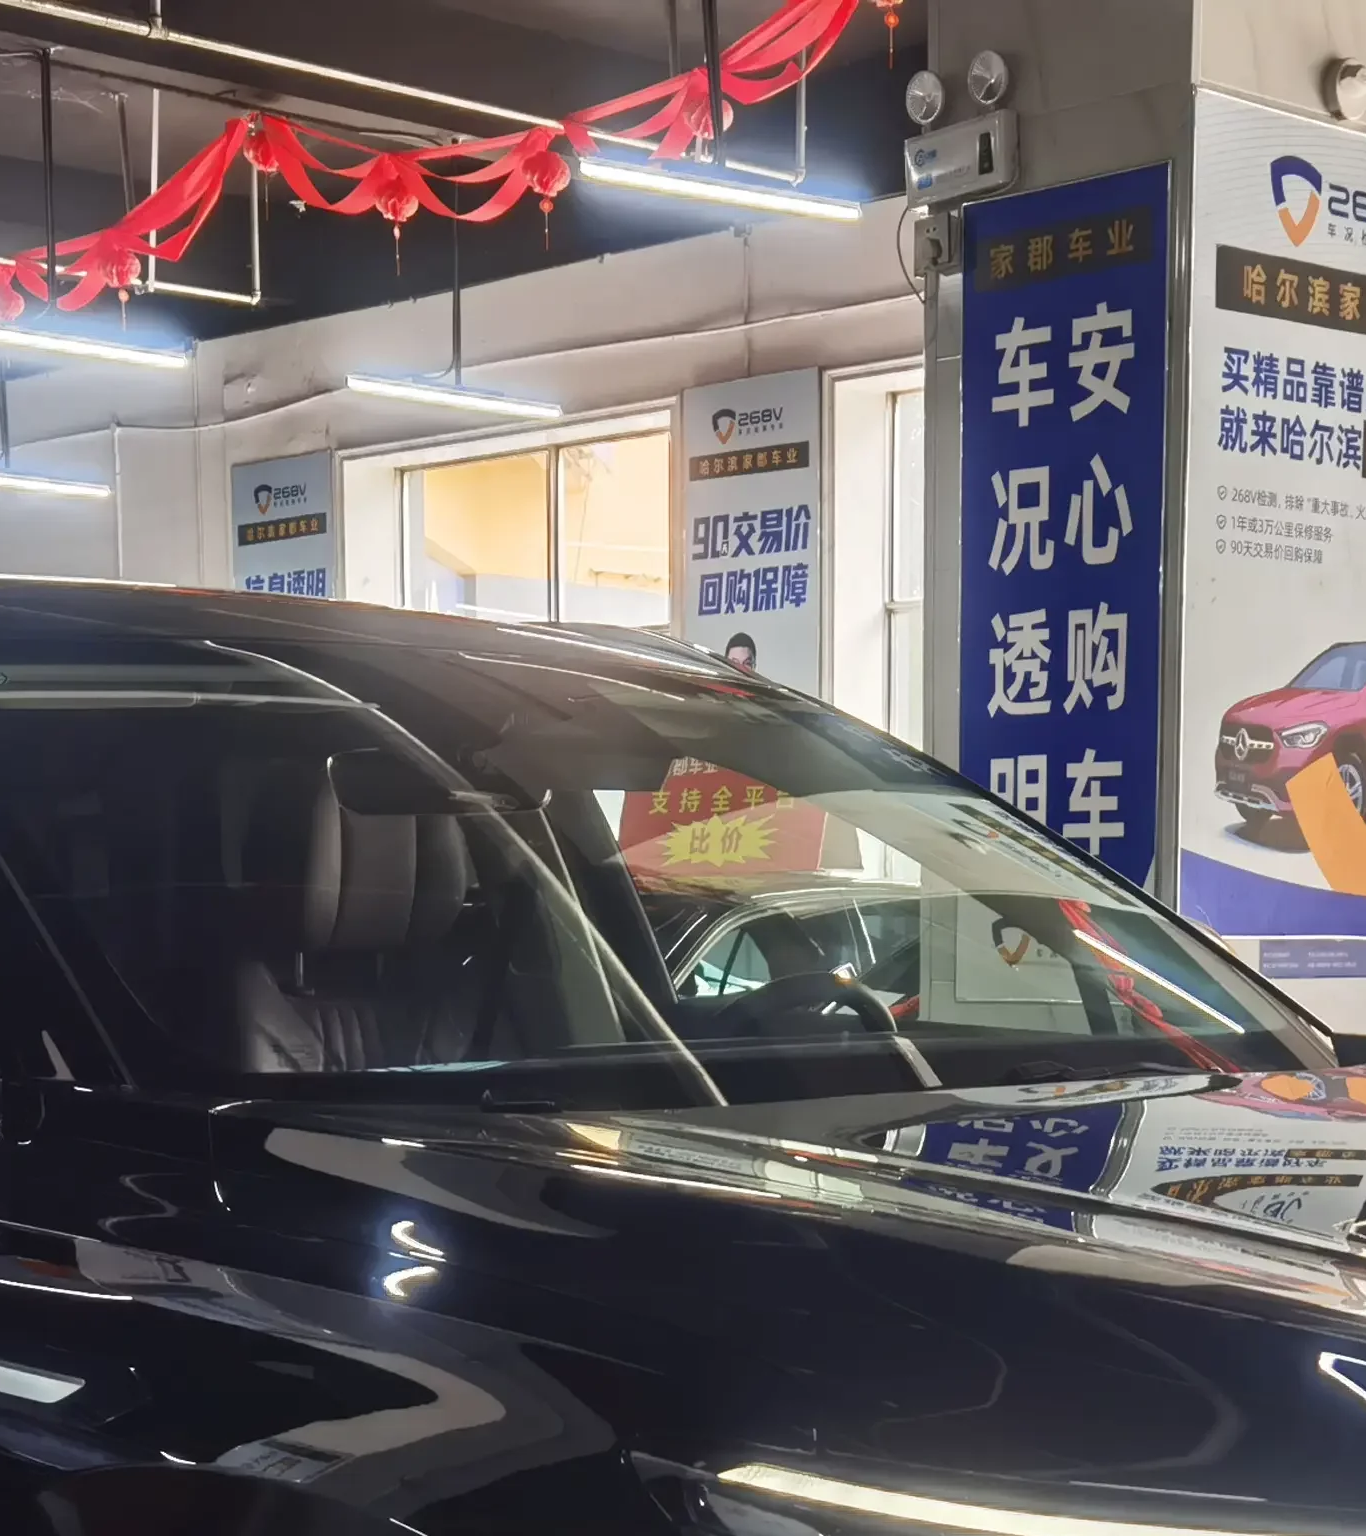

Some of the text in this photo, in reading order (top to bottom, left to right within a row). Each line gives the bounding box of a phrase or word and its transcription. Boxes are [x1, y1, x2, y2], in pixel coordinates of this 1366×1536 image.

[989, 218, 1134, 281] 家郡车业
[737, 406, 784, 427] 268V
[273, 481, 307, 500] 268V
[697, 561, 810, 616] 回购保障
[1063, 301, 1136, 856] 安心购车
[648, 784, 795, 815] 支持全平台
[689, 824, 745, 856] 比价
